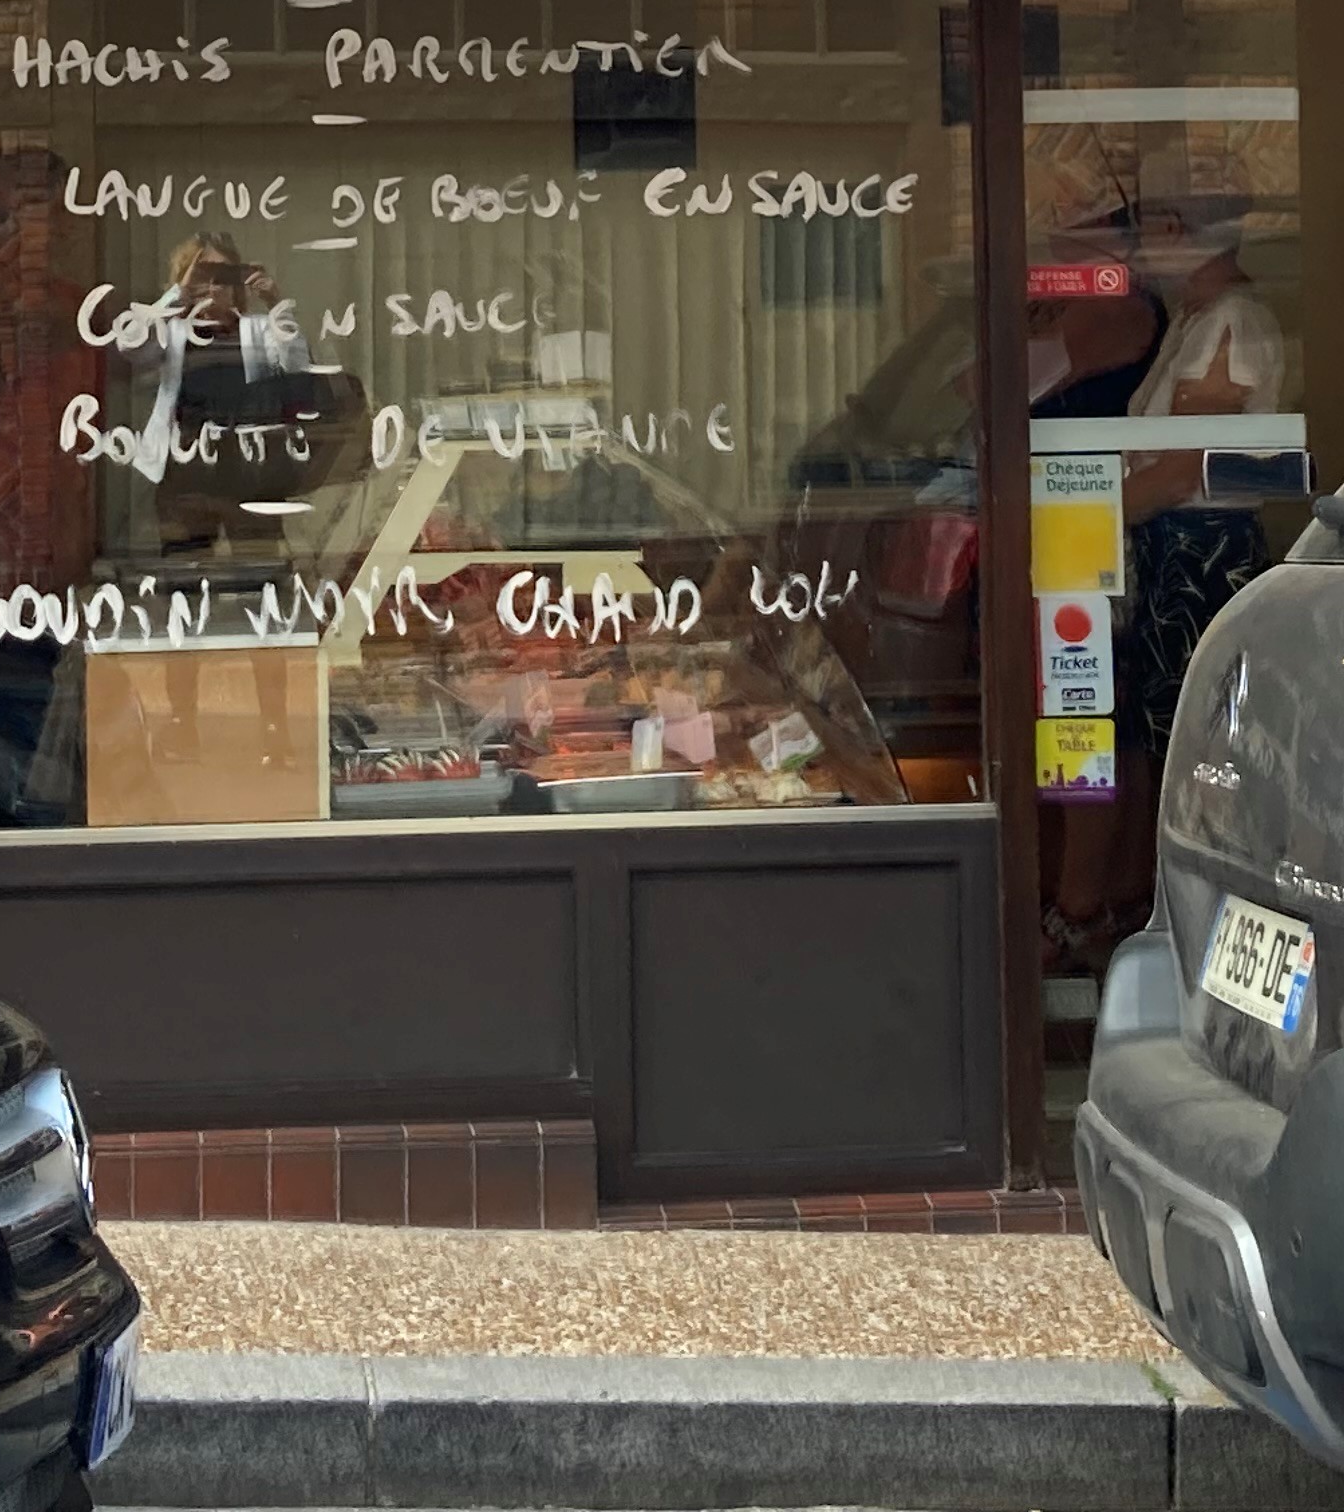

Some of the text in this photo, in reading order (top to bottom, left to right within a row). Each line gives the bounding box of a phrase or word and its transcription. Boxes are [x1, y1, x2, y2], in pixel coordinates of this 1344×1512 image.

[62, 167, 290, 223] LANGUE
[330, 175, 406, 228] DE
[642, 166, 735, 220] EN
[751, 170, 920, 223] SAUCE
[385, 289, 558, 339] SAUCE
[371, 404, 446, 470] DE
[1050, 655, 1099, 671] Ticket
